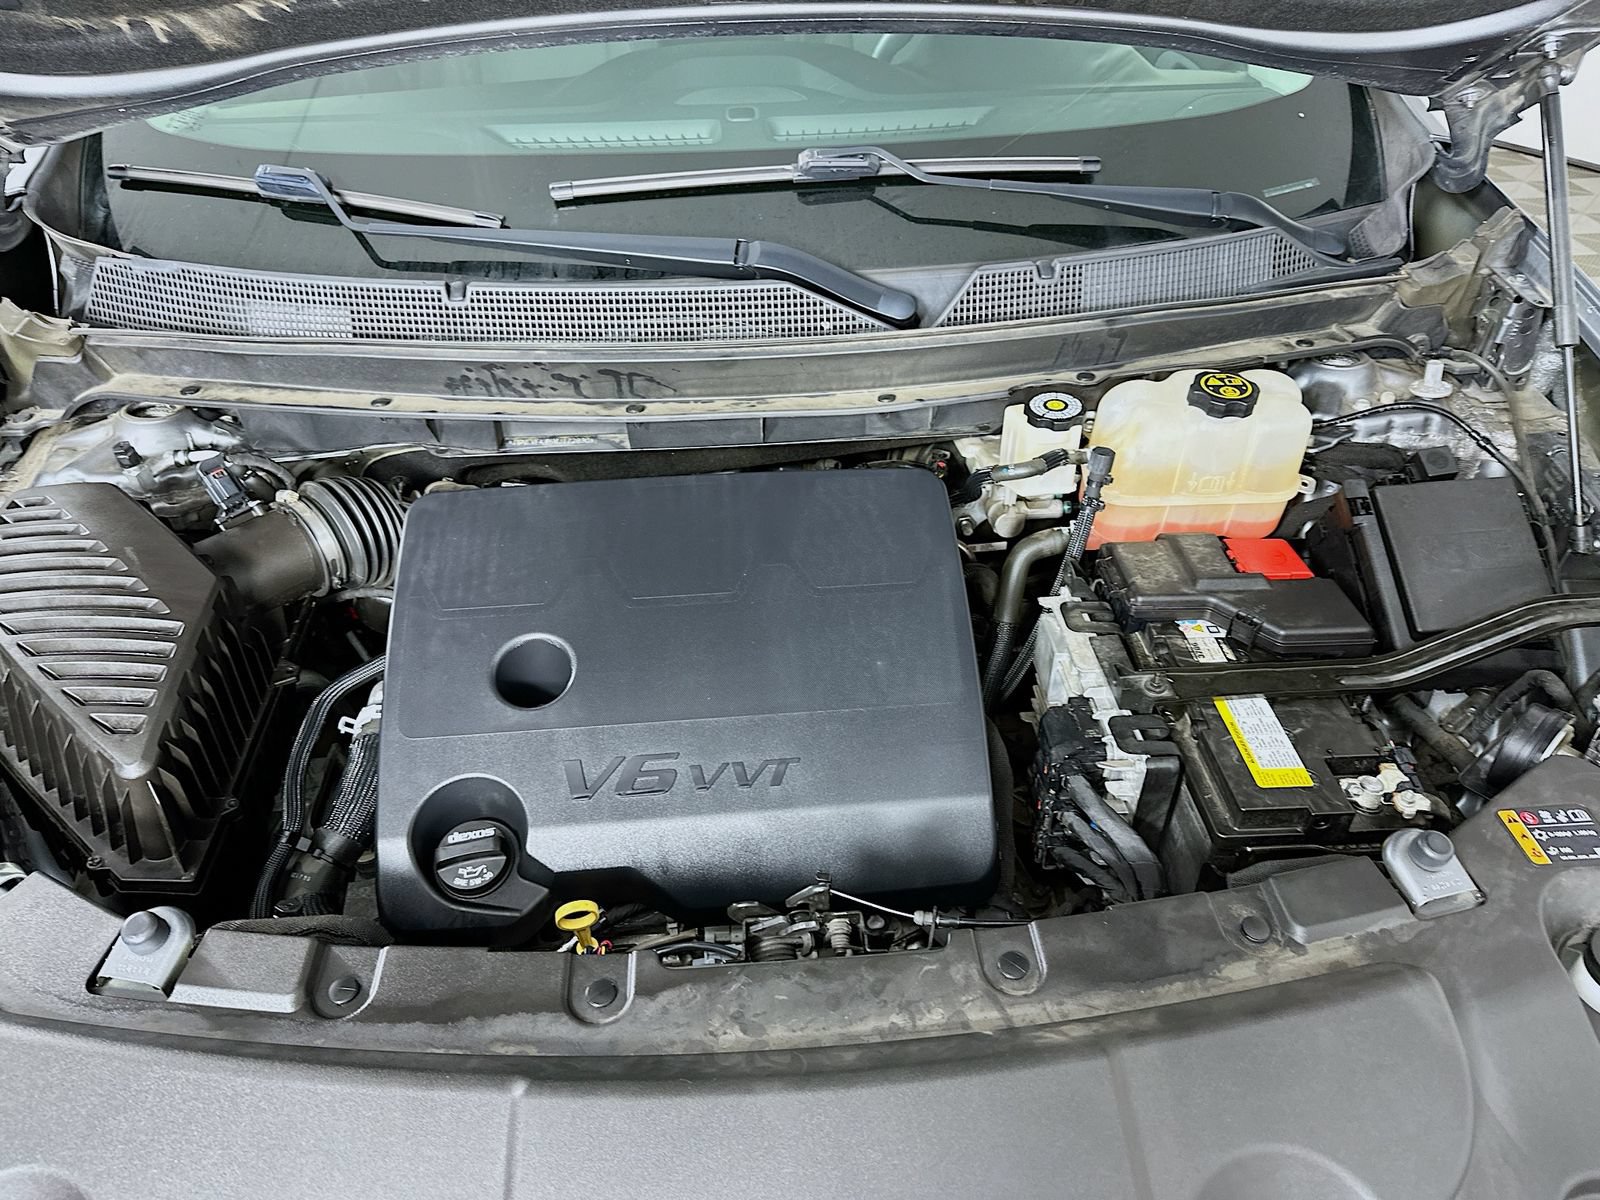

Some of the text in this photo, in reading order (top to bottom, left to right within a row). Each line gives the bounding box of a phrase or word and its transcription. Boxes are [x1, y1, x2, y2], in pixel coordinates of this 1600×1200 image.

[563, 751, 801, 801] V6 VVT
[447, 827, 497, 844] dexos
[453, 872, 494, 887] SAE 5W-30
